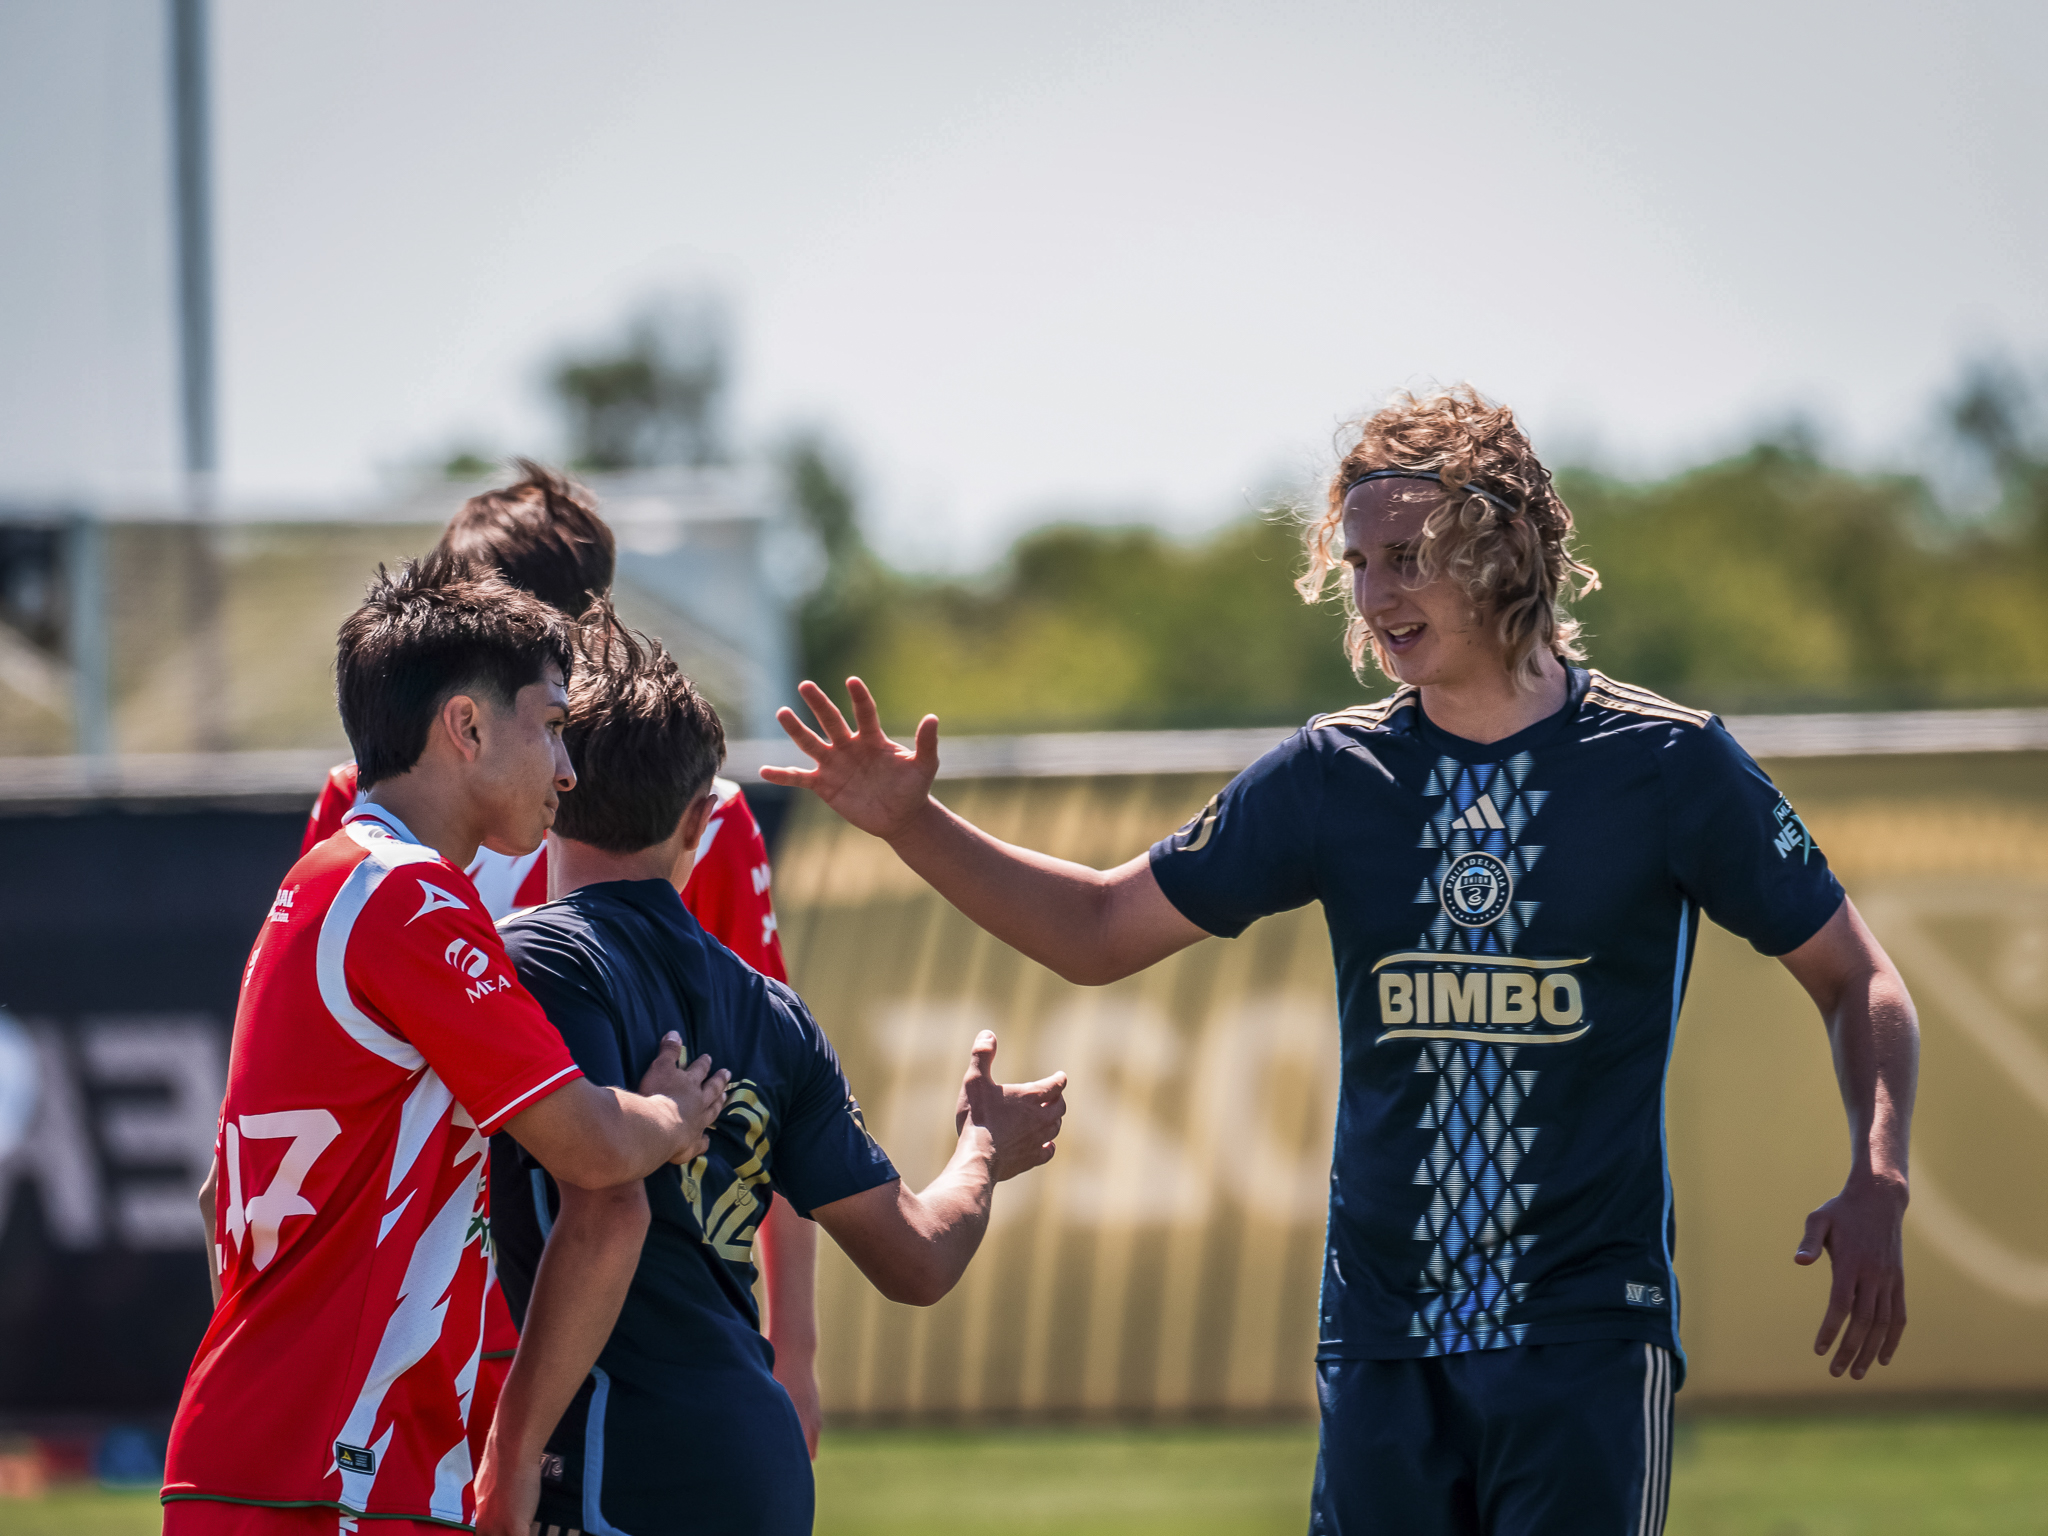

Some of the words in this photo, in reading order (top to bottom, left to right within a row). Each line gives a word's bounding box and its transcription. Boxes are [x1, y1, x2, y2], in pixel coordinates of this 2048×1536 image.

[1446, 858, 1507, 889] PHILADELPHIA
[1463, 876, 1489, 885] UNION
[1379, 972, 1584, 1026] BIMBO
